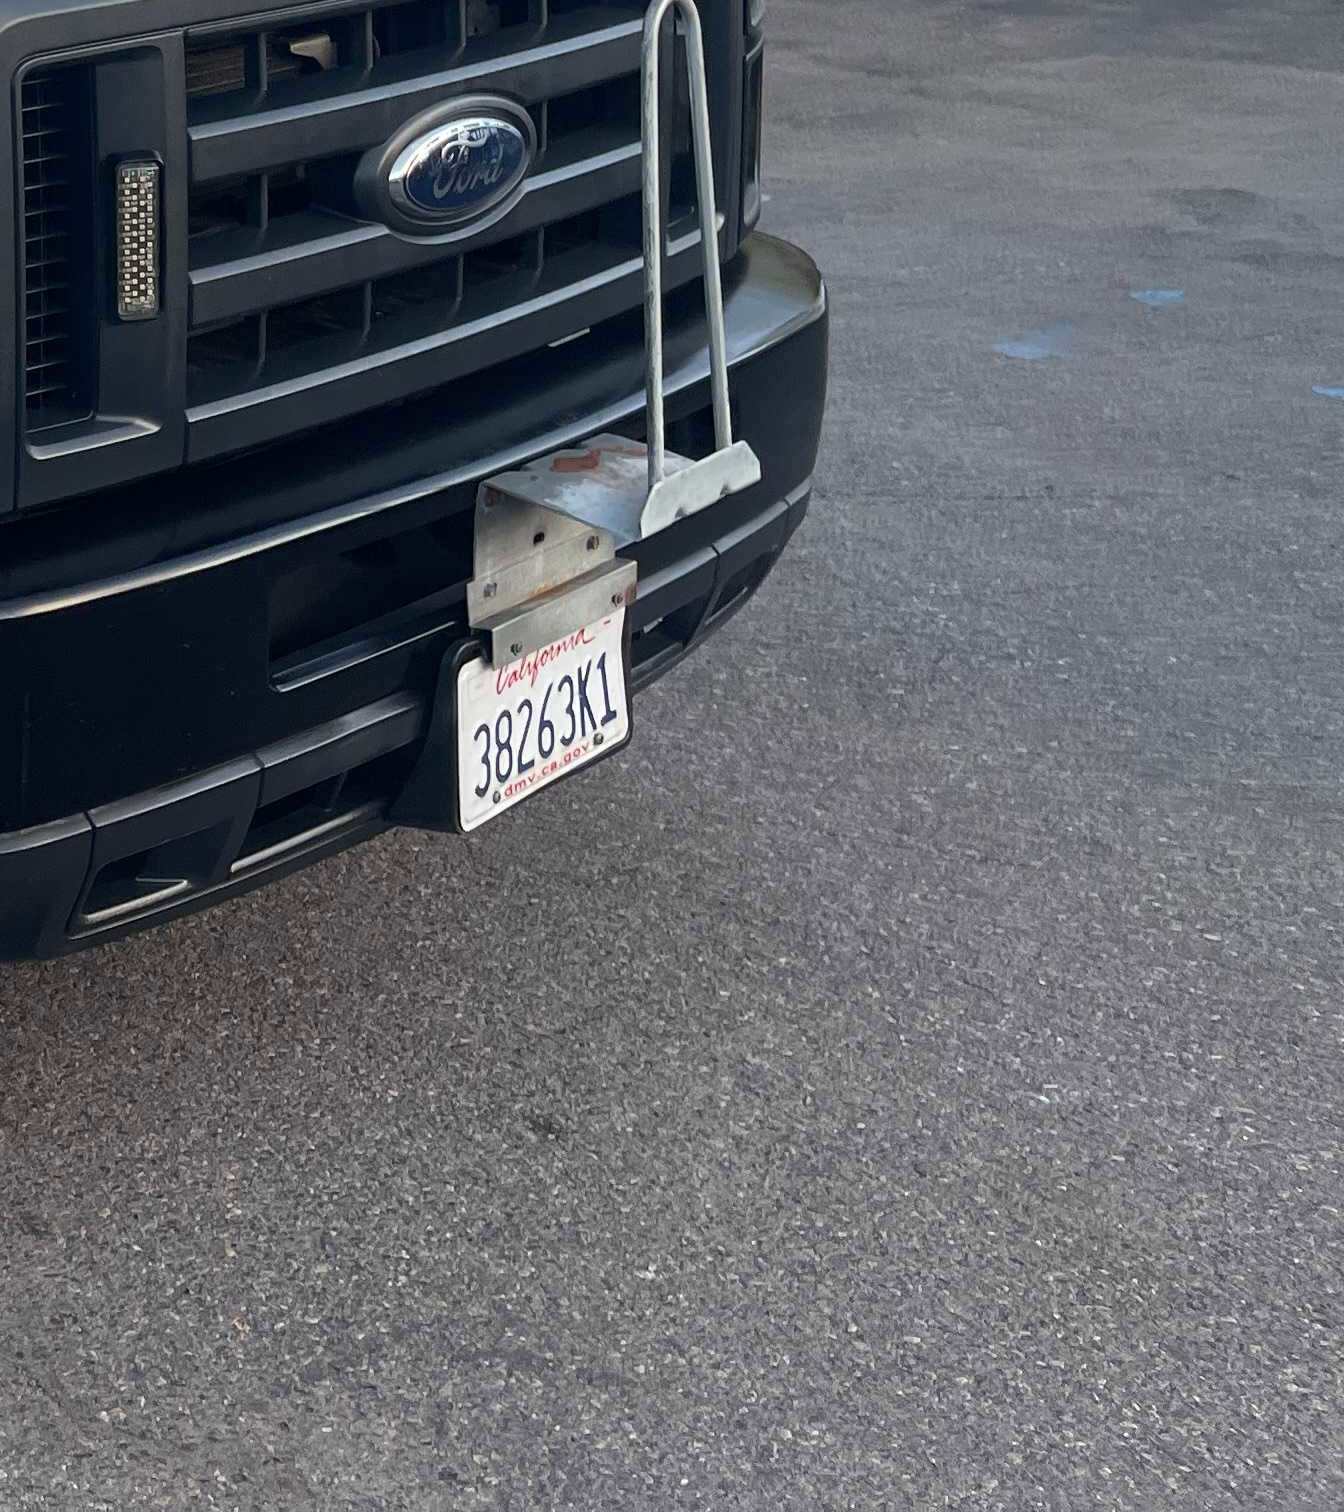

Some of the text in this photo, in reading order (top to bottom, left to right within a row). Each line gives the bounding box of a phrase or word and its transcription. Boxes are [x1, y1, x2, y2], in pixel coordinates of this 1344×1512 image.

[495, 627, 596, 696] California
[473, 651, 618, 799] 38263K1
[503, 742, 591, 799] dmv.ca.gov
